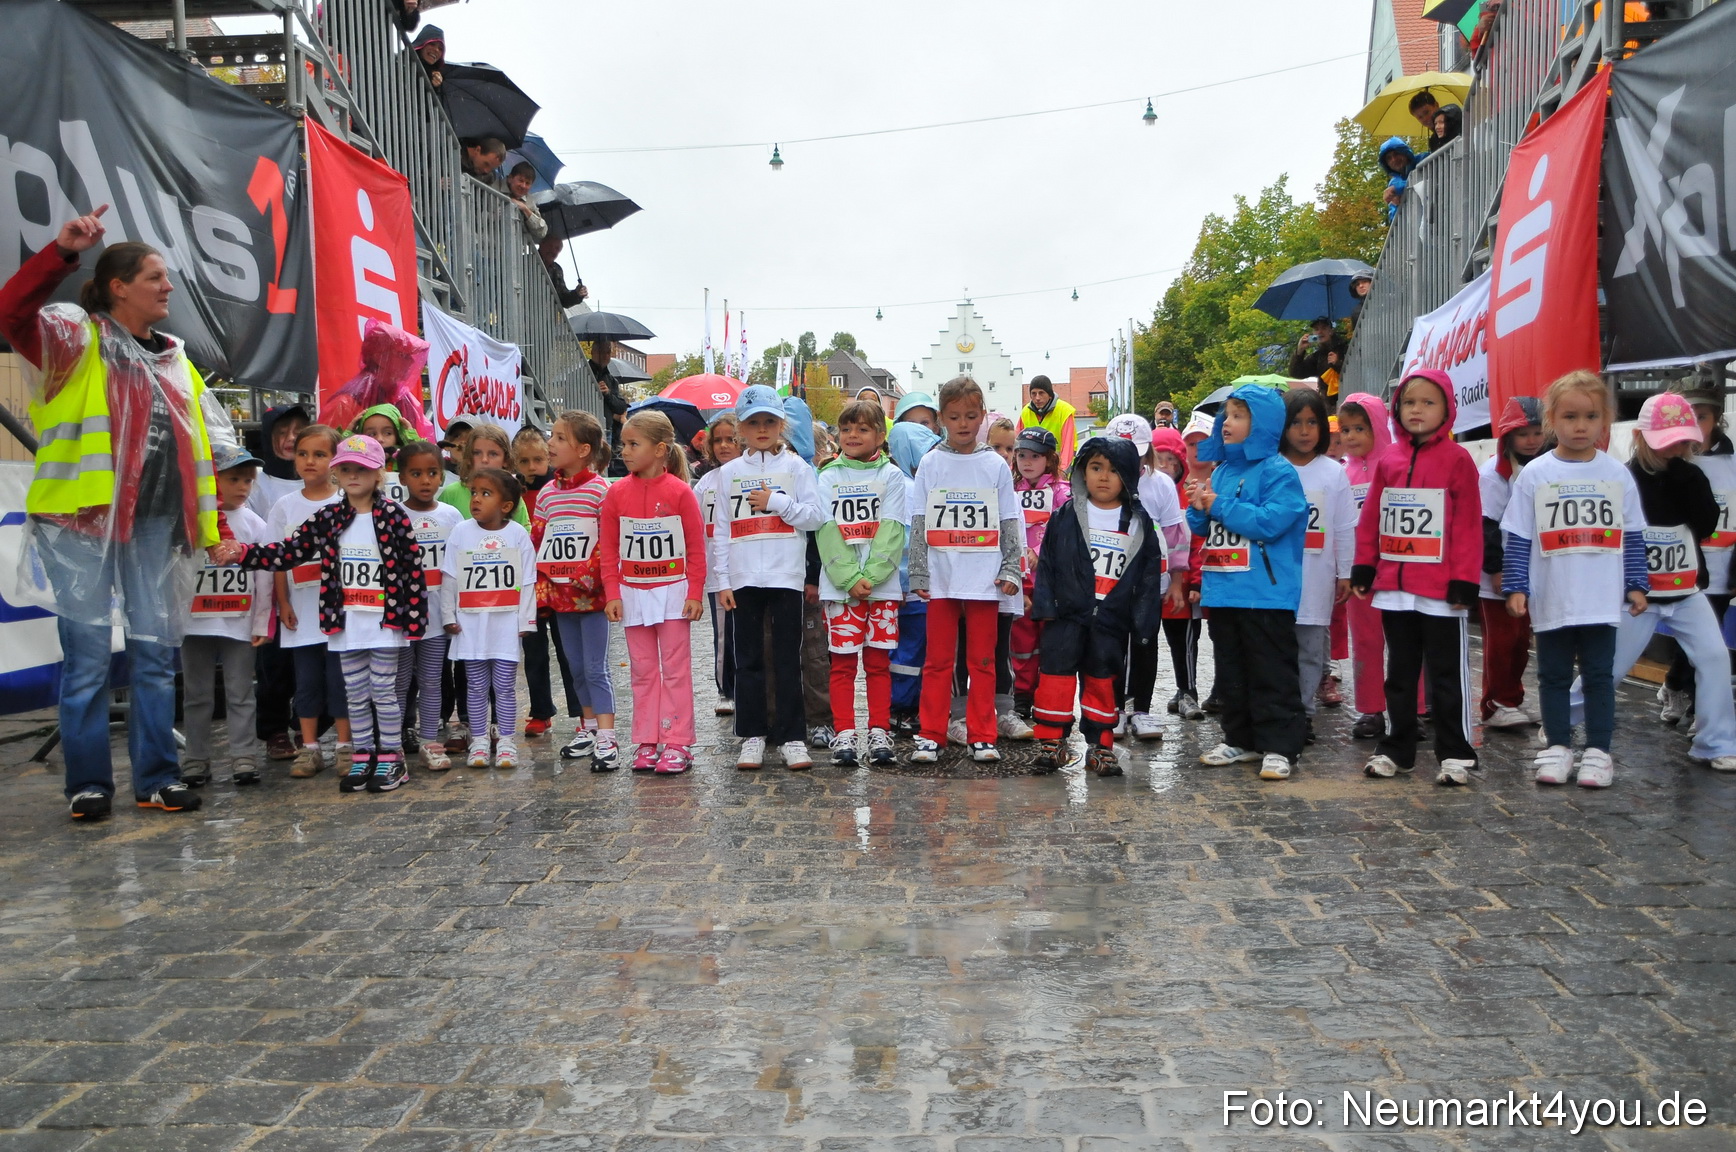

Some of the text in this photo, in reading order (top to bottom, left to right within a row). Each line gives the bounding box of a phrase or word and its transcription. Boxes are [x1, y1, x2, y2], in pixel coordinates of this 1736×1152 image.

[838, 485, 869, 494] BOCK
[1559, 485, 1596, 494] BOCK
[946, 492, 977, 500] BOCK
[1021, 490, 1045, 509] 83
[1388, 493, 1416, 502] BOCK
[933, 505, 989, 529] 7131
[1545, 499, 1613, 528] 7036
[633, 523, 661, 531] BOCK
[1382, 507, 1433, 535] 7152
[553, 524, 575, 532] BOCK
[844, 525, 873, 537] Stella
[949, 533, 976, 544] Lucia
[1558, 533, 1604, 545] Kristina
[1646, 532, 1677, 541] BOCK
[543, 536, 590, 560] 7067
[625, 534, 675, 559] 7101
[473, 553, 501, 561] BOCK
[1090, 548, 1127, 577] 213
[1646, 544, 1689, 571] 302
[342, 562, 384, 588] 084
[633, 564, 667, 576] Svenja
[195, 569, 248, 593] 7129
[463, 565, 515, 589] 7210
[203, 598, 240, 611] Mirjam
